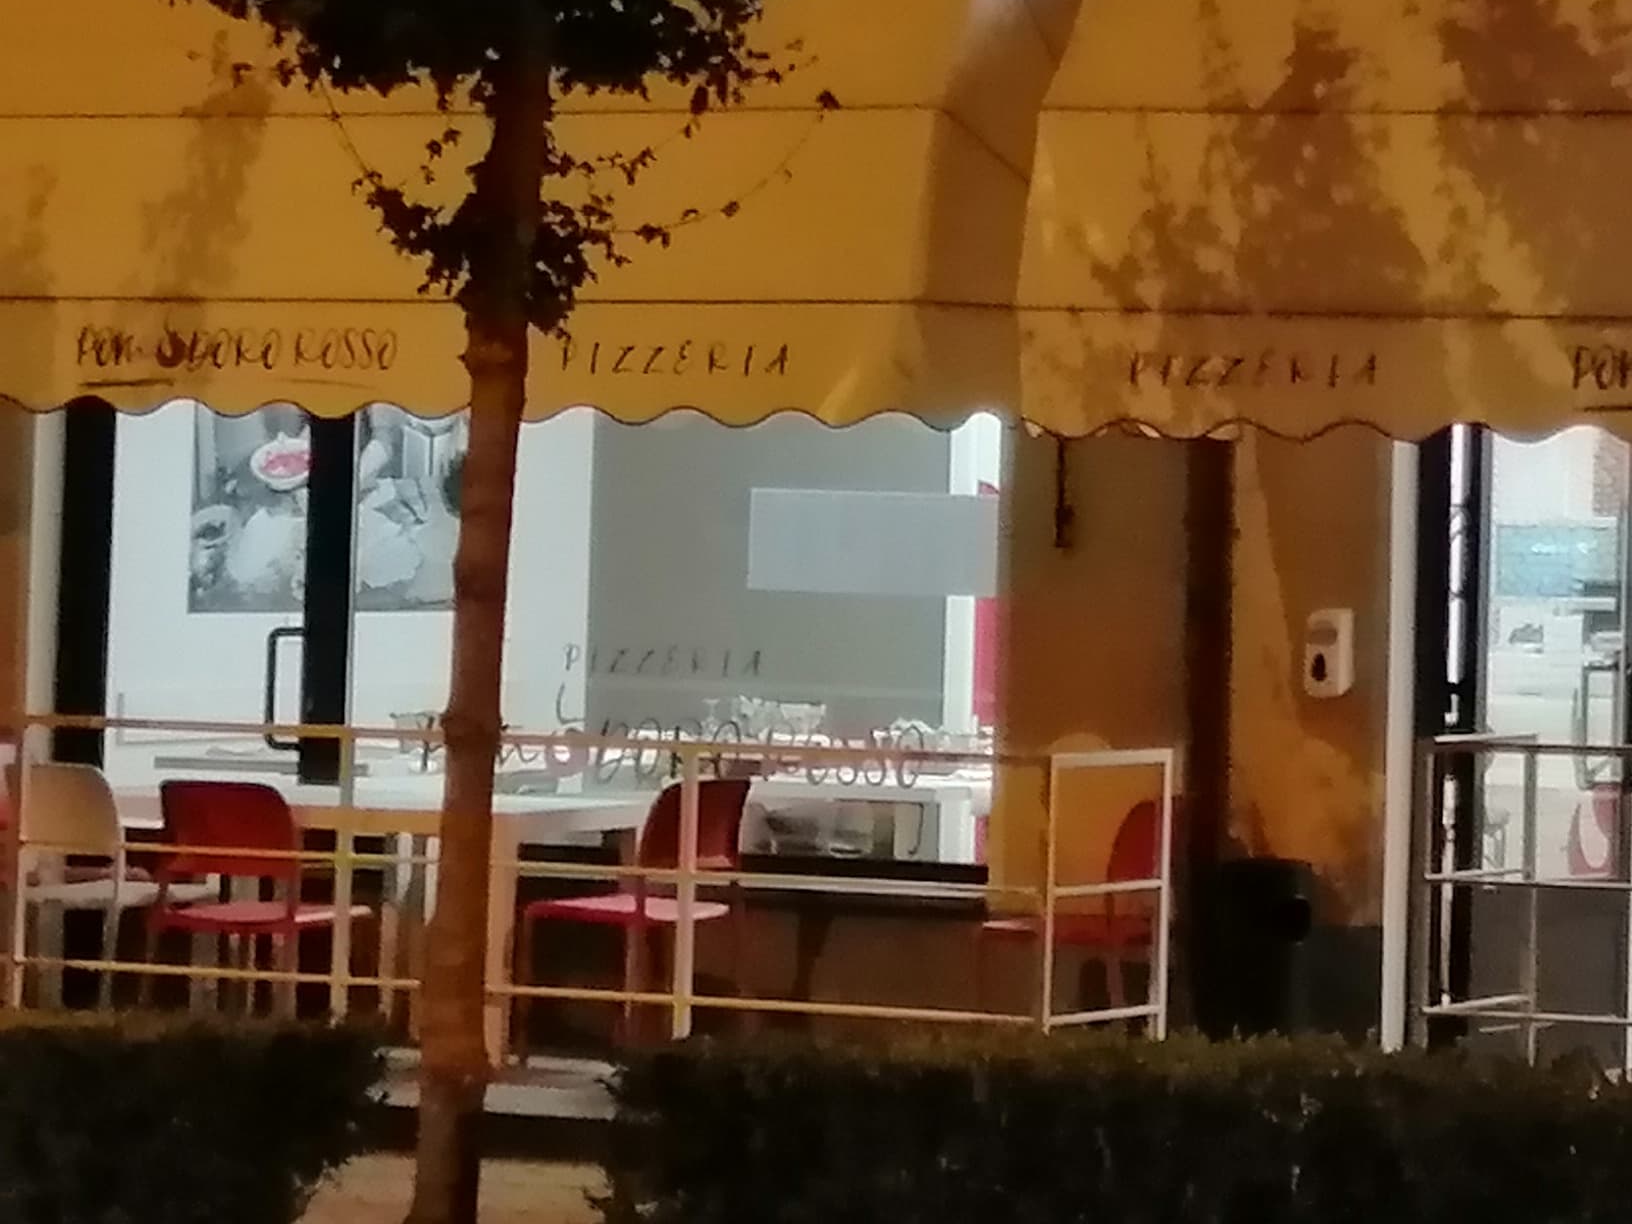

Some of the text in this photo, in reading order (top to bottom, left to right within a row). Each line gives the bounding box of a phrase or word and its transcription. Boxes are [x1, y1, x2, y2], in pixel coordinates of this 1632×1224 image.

[78, 324, 398, 373] POMODORO ROSSO
[560, 338, 790, 378] PIZZERIA
[1128, 348, 1378, 388] PIZZERIA
[564, 642, 763, 678] PIZZERIA
